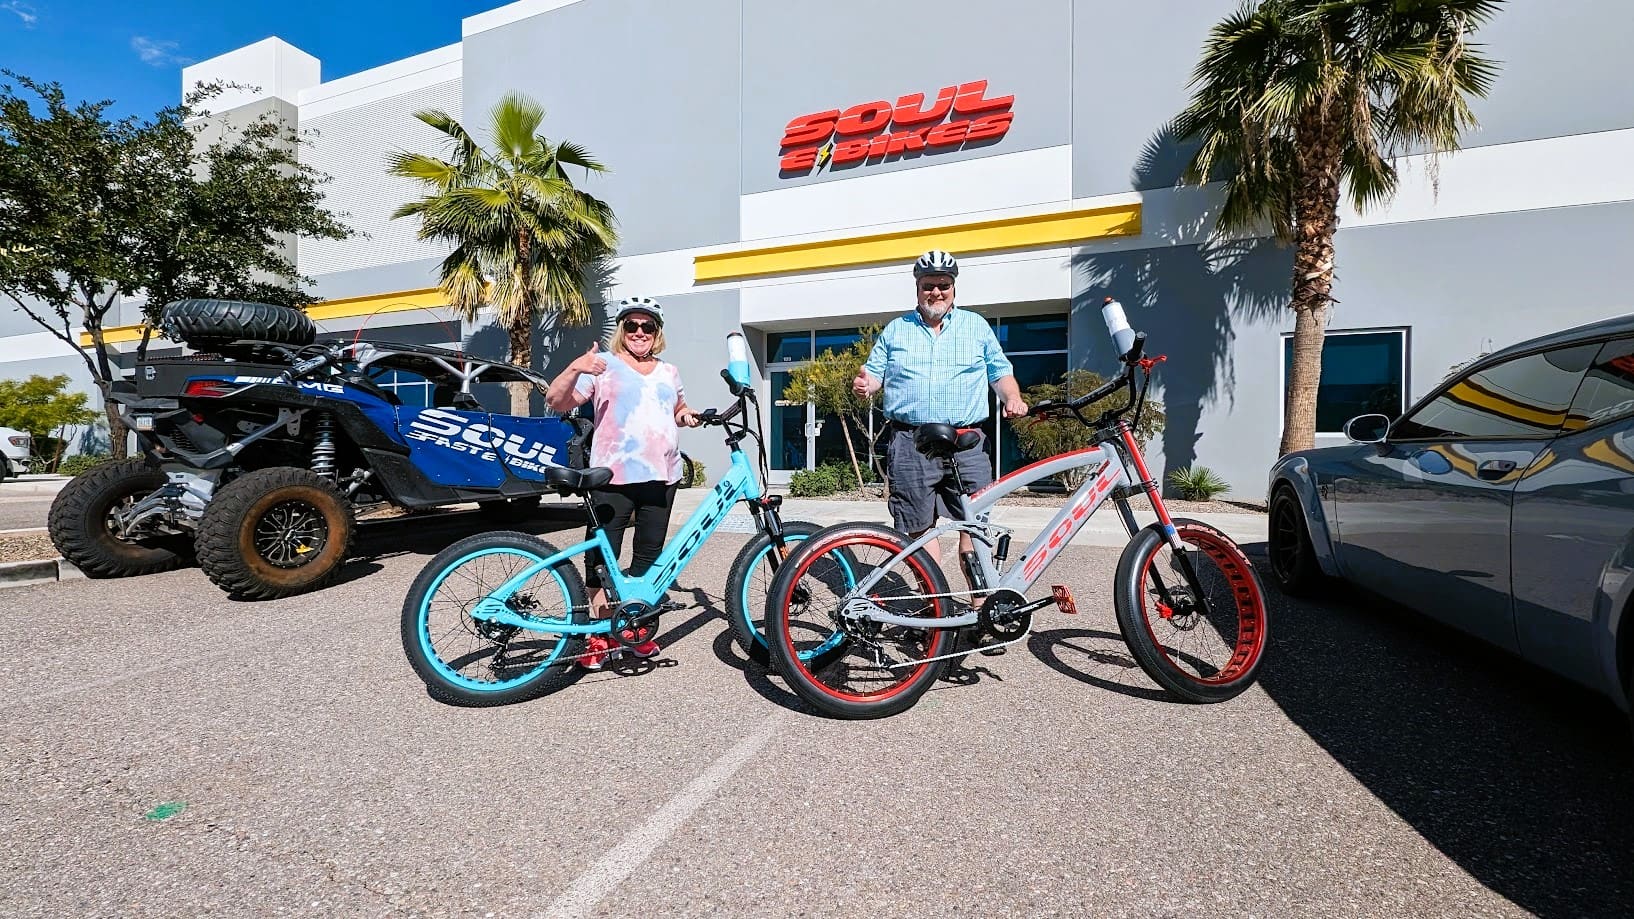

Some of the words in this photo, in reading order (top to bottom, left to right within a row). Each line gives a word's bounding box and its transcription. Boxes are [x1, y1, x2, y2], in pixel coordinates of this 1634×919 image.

[779, 80, 1014, 151] SOUL
[410, 408, 568, 469] SOUL
[653, 476, 747, 594] SOUL
[1023, 467, 1121, 581] SOUL
